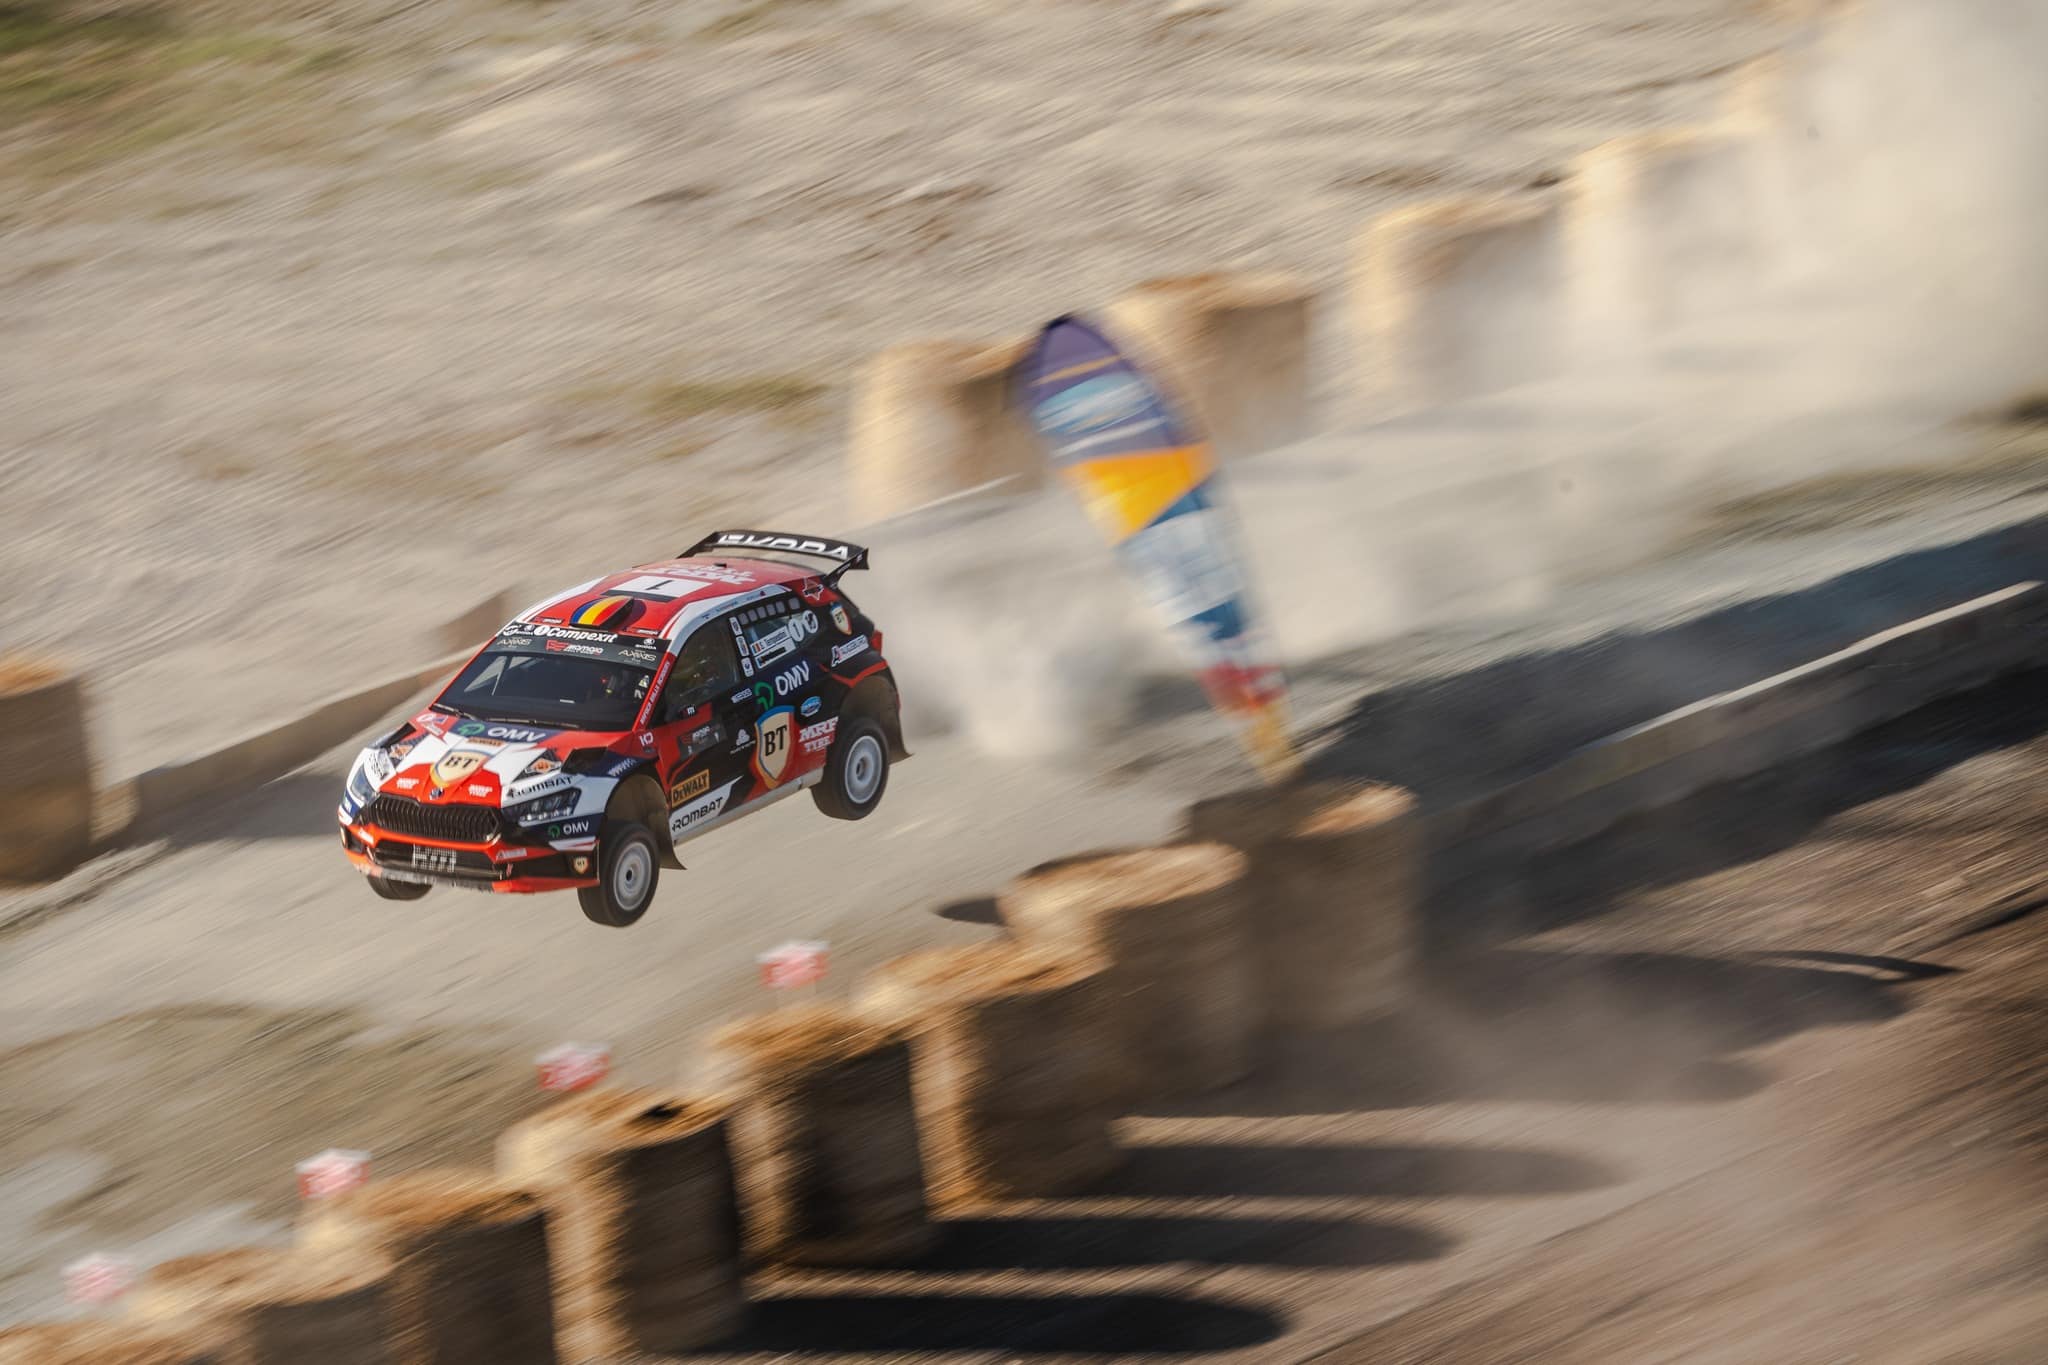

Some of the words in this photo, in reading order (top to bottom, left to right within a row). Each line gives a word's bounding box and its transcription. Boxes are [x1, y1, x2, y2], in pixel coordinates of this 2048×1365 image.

[546, 628, 618, 643] Compexit
[775, 661, 810, 696] OMV
[488, 727, 546, 742] OMV
[798, 716, 839, 743] MRF
[764, 725, 787, 757] BT
[445, 756, 479, 769] BT
[673, 797, 724, 830] ROMBAT
[563, 822, 590, 835] OMV
